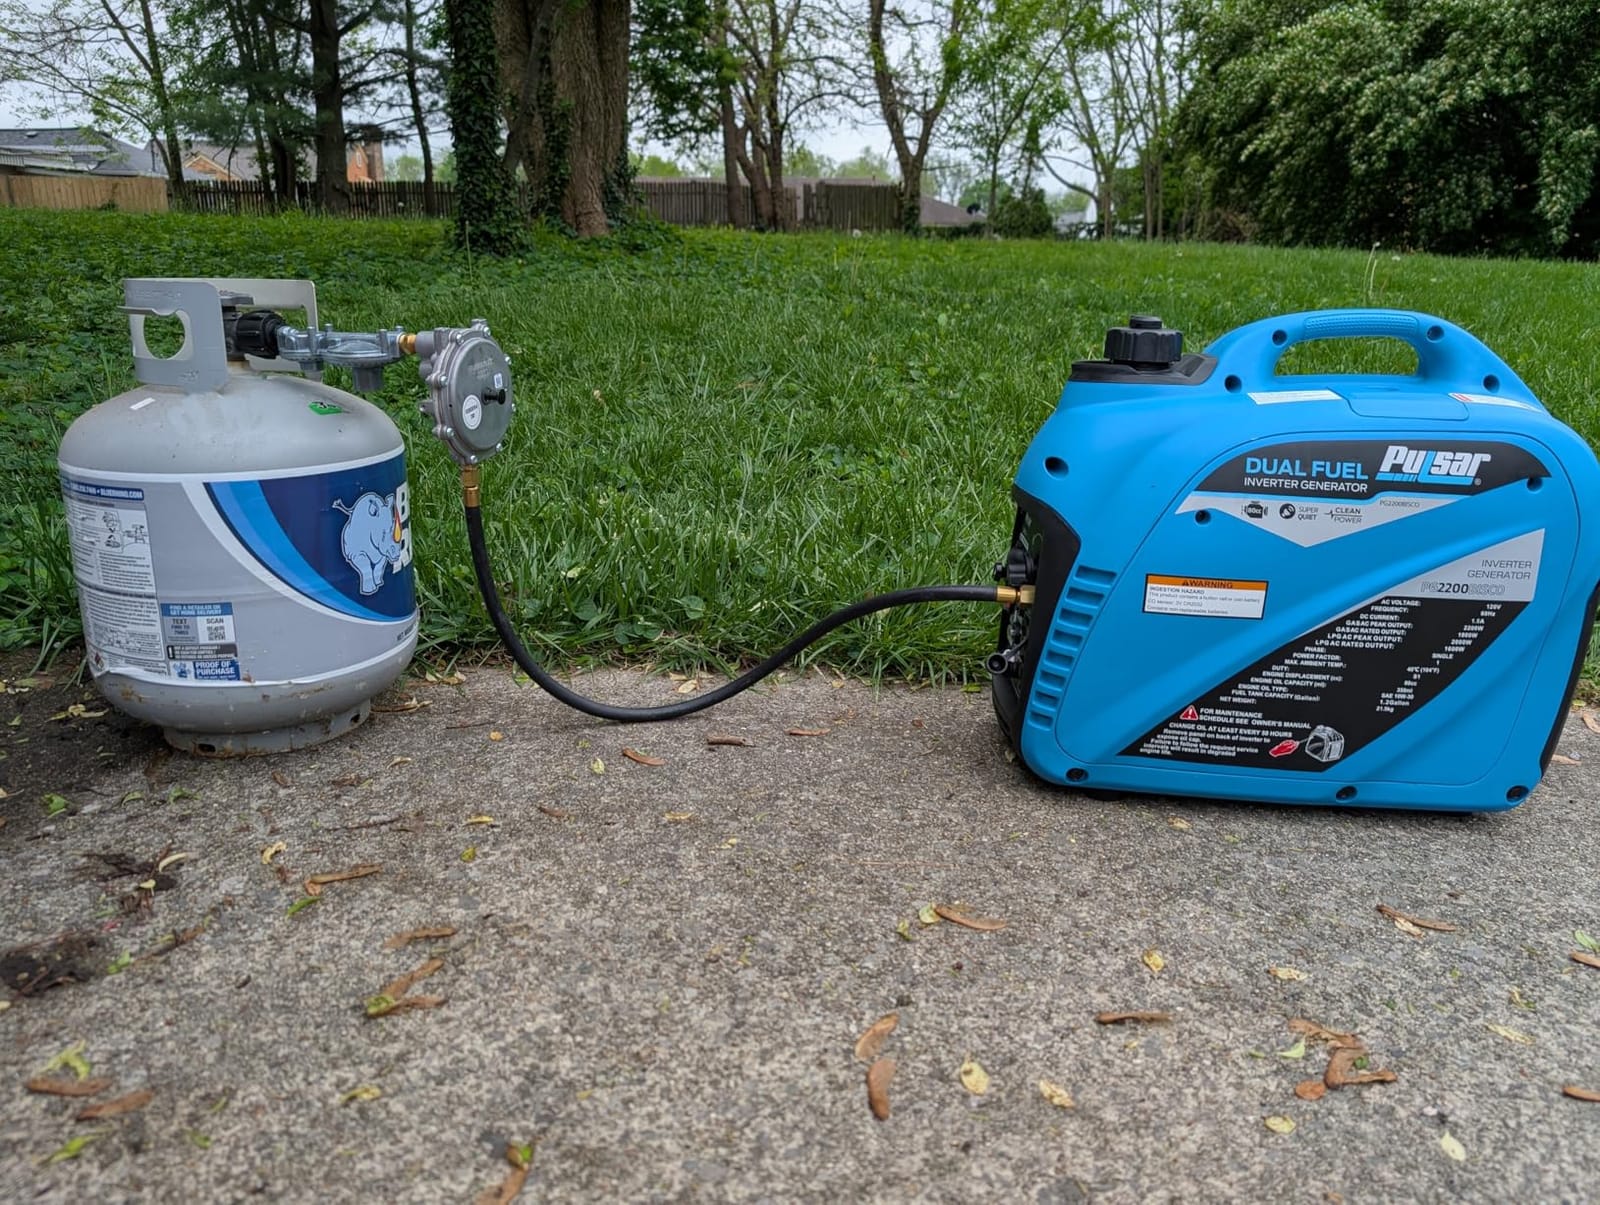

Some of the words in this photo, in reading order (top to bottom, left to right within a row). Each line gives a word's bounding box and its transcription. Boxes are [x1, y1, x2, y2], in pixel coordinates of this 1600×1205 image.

[1245, 457, 1308, 477] DUAL
[1311, 460, 1369, 480] FUEL
[1244, 476, 1299, 490] INVERTER
[1300, 478, 1368, 493] GENERATOR
[1335, 507, 1361, 515] CLEAN
[1334, 516, 1362, 524] POWER
[1481, 559, 1532, 569] INVERTER
[1467, 570, 1531, 580] GENERATOR
[1187, 580, 1233, 589] WARNING
[1371, 605, 1409, 613] FREQUENCY:
[1381, 628, 1407, 636] OUTPUT:
[1373, 635, 1402, 643] OUTPUT:
[1293, 652, 1314, 660] POWER
[1315, 653, 1341, 661] FACTOR:
[1299, 659, 1326, 667] AMBIENT
[196, 667, 236, 675] PURCHASE
[1285, 672, 1330, 680] DISPLACEMENT
[1284, 679, 1313, 687] CAPACITY
[1264, 691, 1293, 699] CAPACITY
[1232, 697, 1256, 705] WEIGHT:
[1215, 709, 1262, 718] MAINTENANCE
[1199, 714, 1235, 724] SCHEDULE
[1251, 719, 1282, 727] OWNER'S
[1283, 721, 1312, 729] MANUAL
[1163, 728, 1188, 736] Remove
[1189, 730, 1206, 738] panel
[1215, 731, 1231, 740] back
[1231, 732, 1238, 740] of
[1218, 725, 1238, 733] LEAST
[1239, 727, 1260, 735] EVERY
[1269, 729, 1292, 737] HOURS
[1180, 740, 1198, 748] follow
[1210, 744, 1236, 752] required
